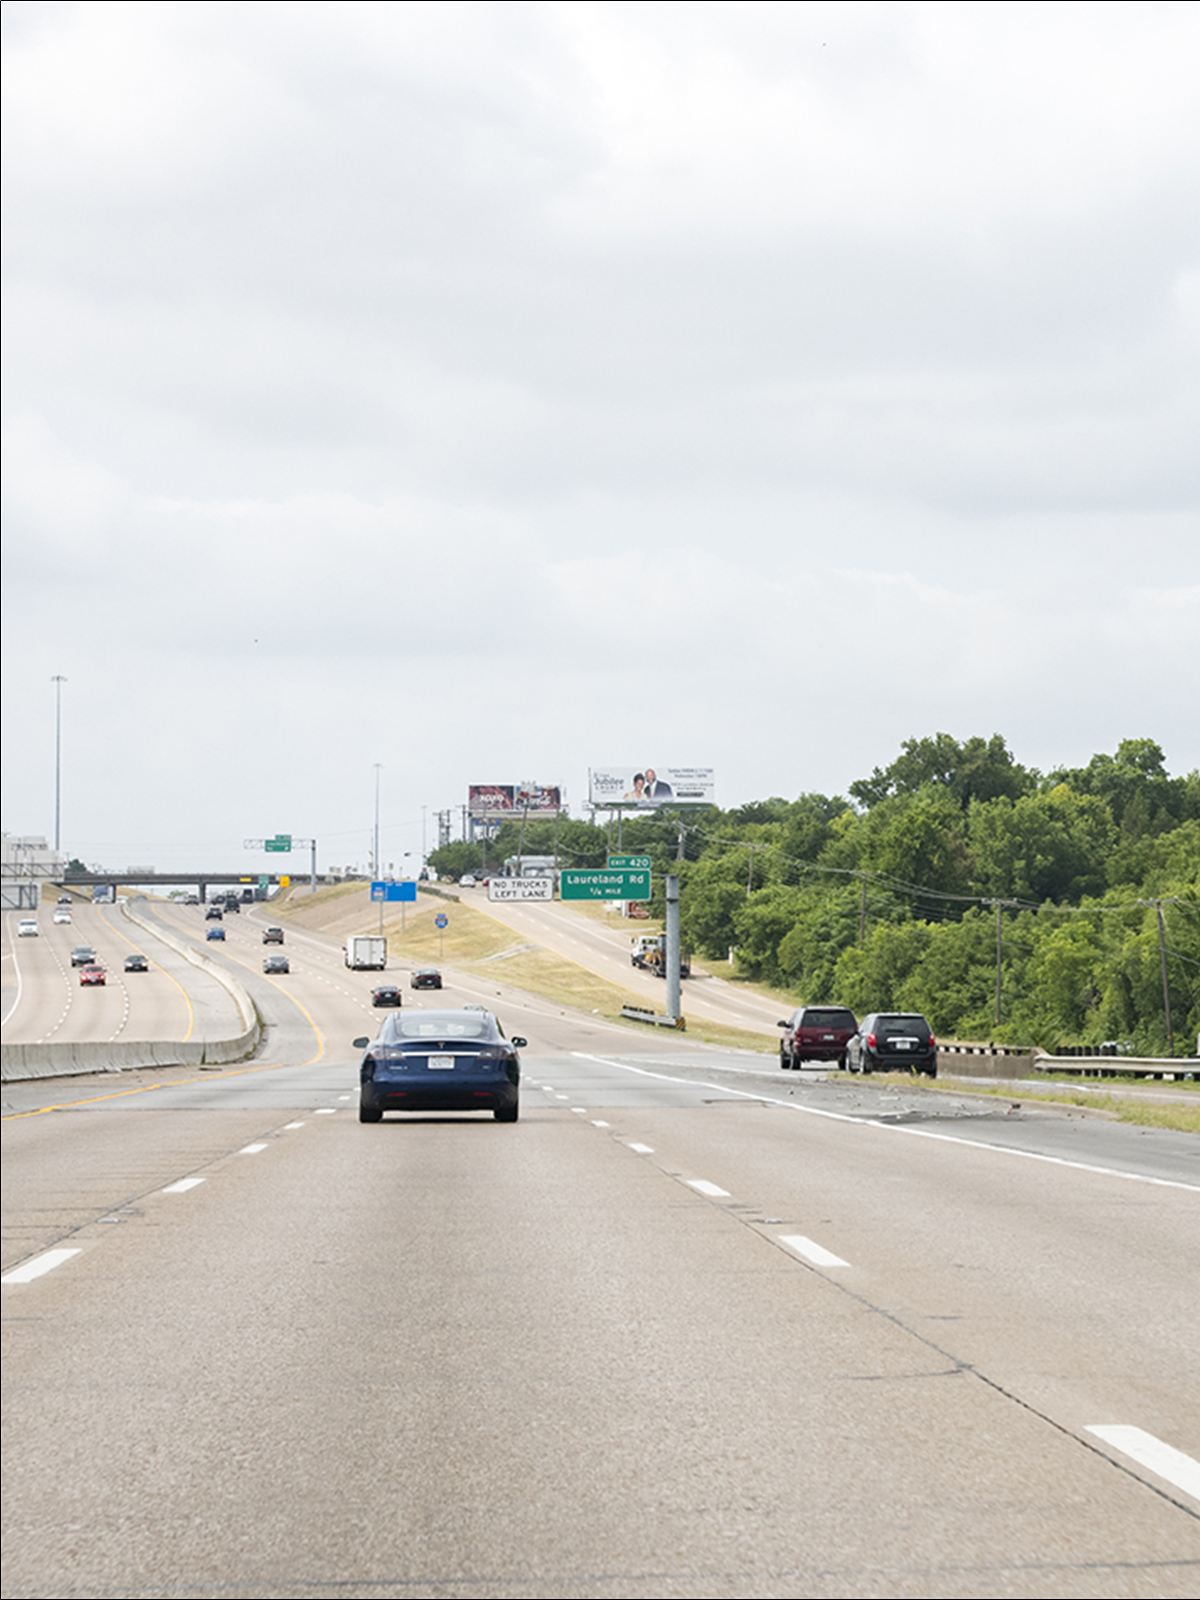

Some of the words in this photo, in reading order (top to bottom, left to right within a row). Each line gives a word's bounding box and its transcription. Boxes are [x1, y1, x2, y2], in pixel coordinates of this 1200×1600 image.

[629, 858, 649, 867] 420
[567, 874, 624, 884] Laureland
[629, 874, 644, 884] Rd
[493, 881, 507, 889] NO
[511, 880, 548, 889] TRUCKS
[494, 890, 517, 898] LEFT
[521, 890, 547, 898] LANE
